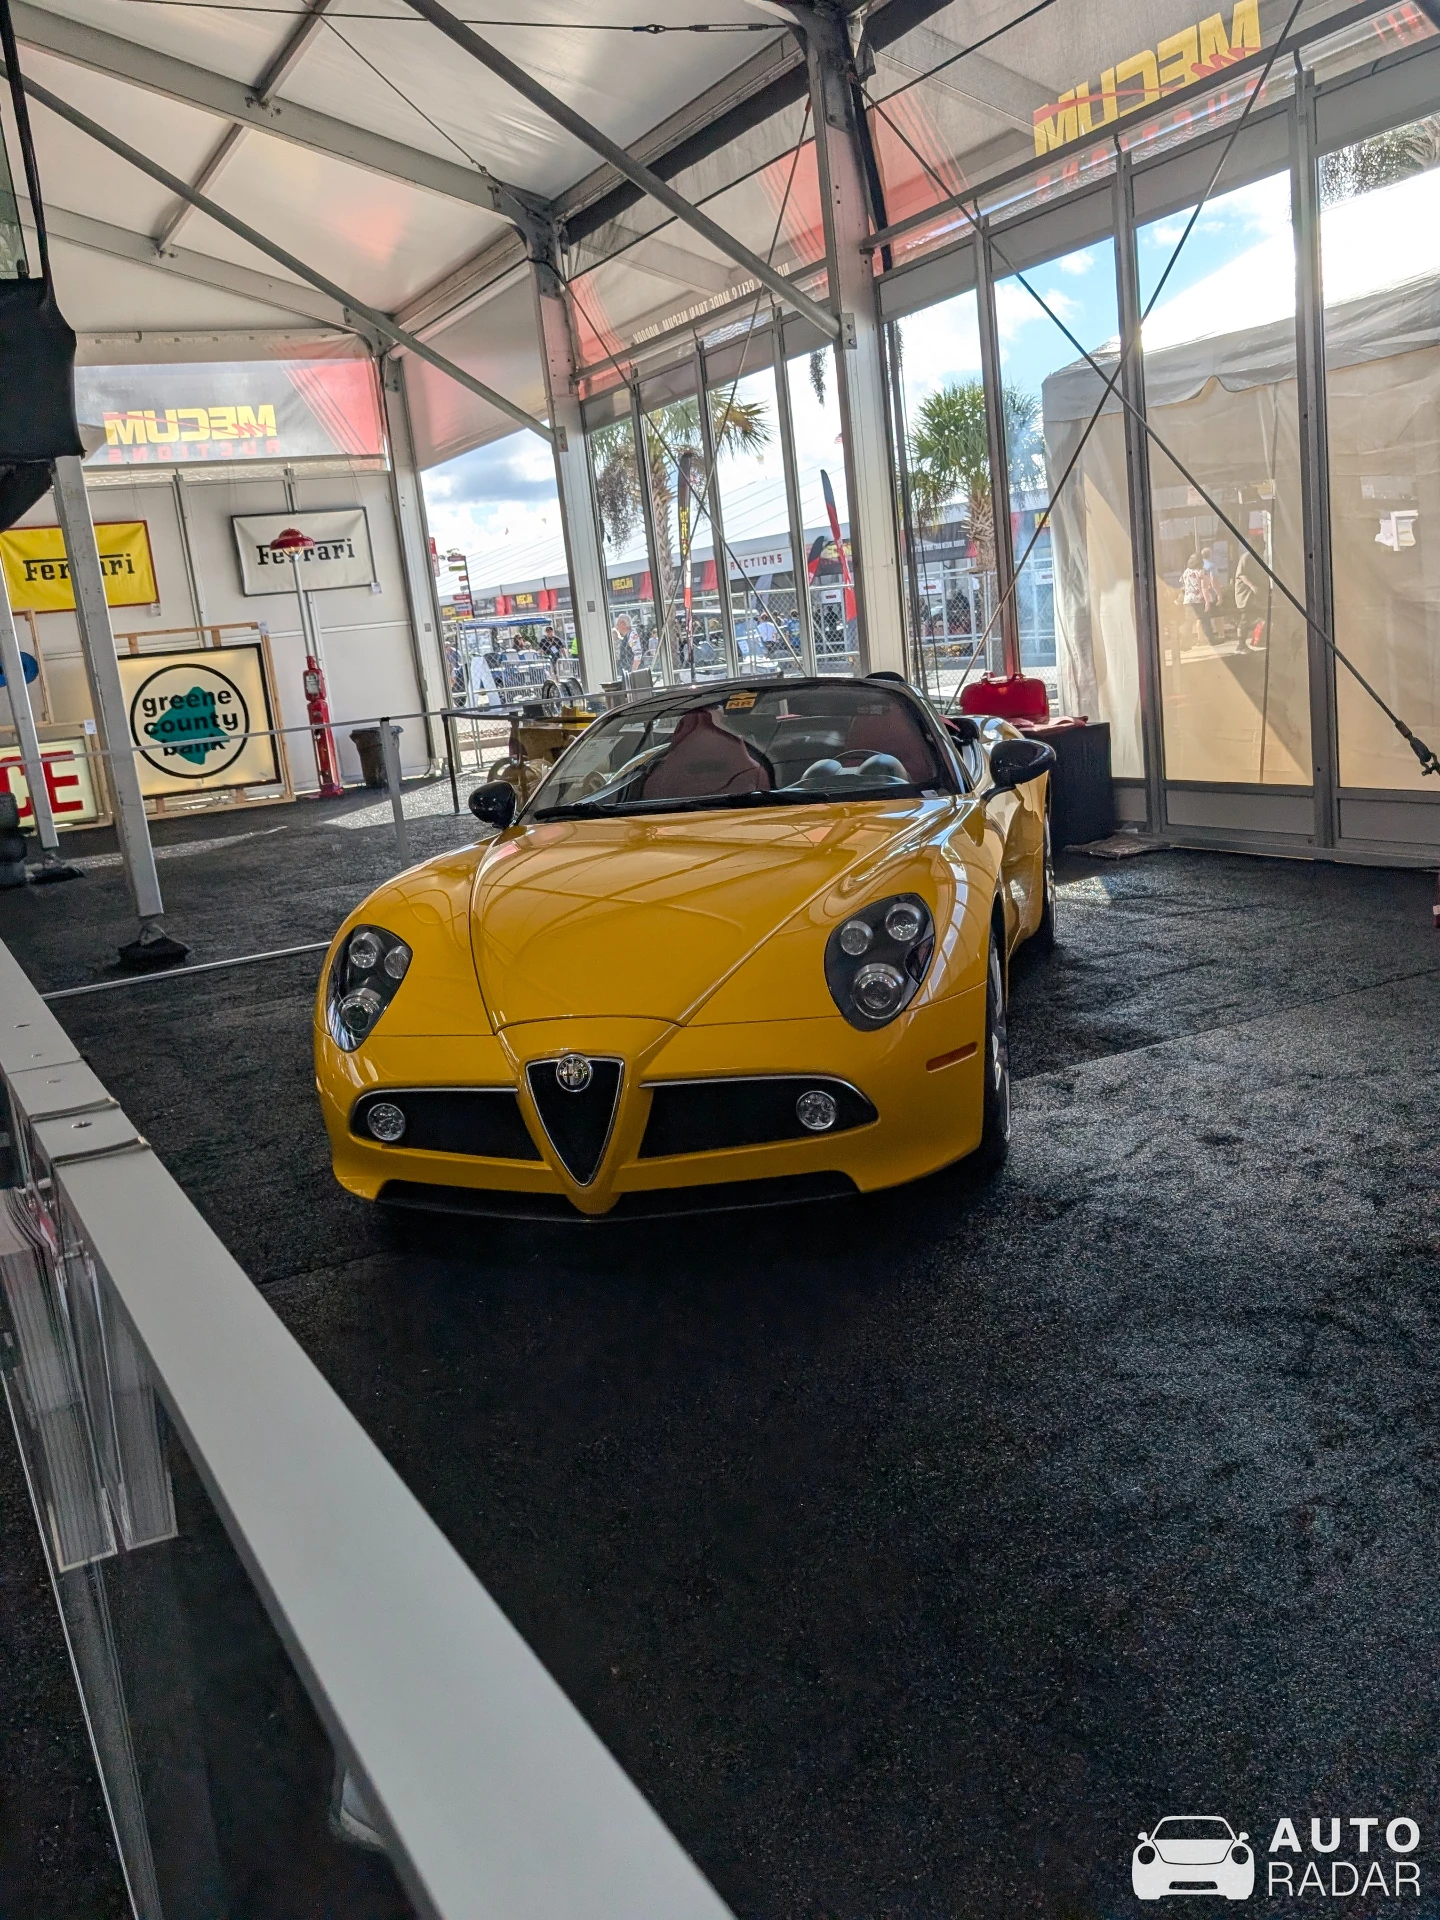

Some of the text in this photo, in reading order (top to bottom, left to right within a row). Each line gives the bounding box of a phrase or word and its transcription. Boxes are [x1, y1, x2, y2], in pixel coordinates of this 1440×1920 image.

[256, 538, 356, 566] Ferari
[22, 553, 135, 582] Ferri
[142, 689, 232, 718] greene
[143, 711, 239, 735] county
